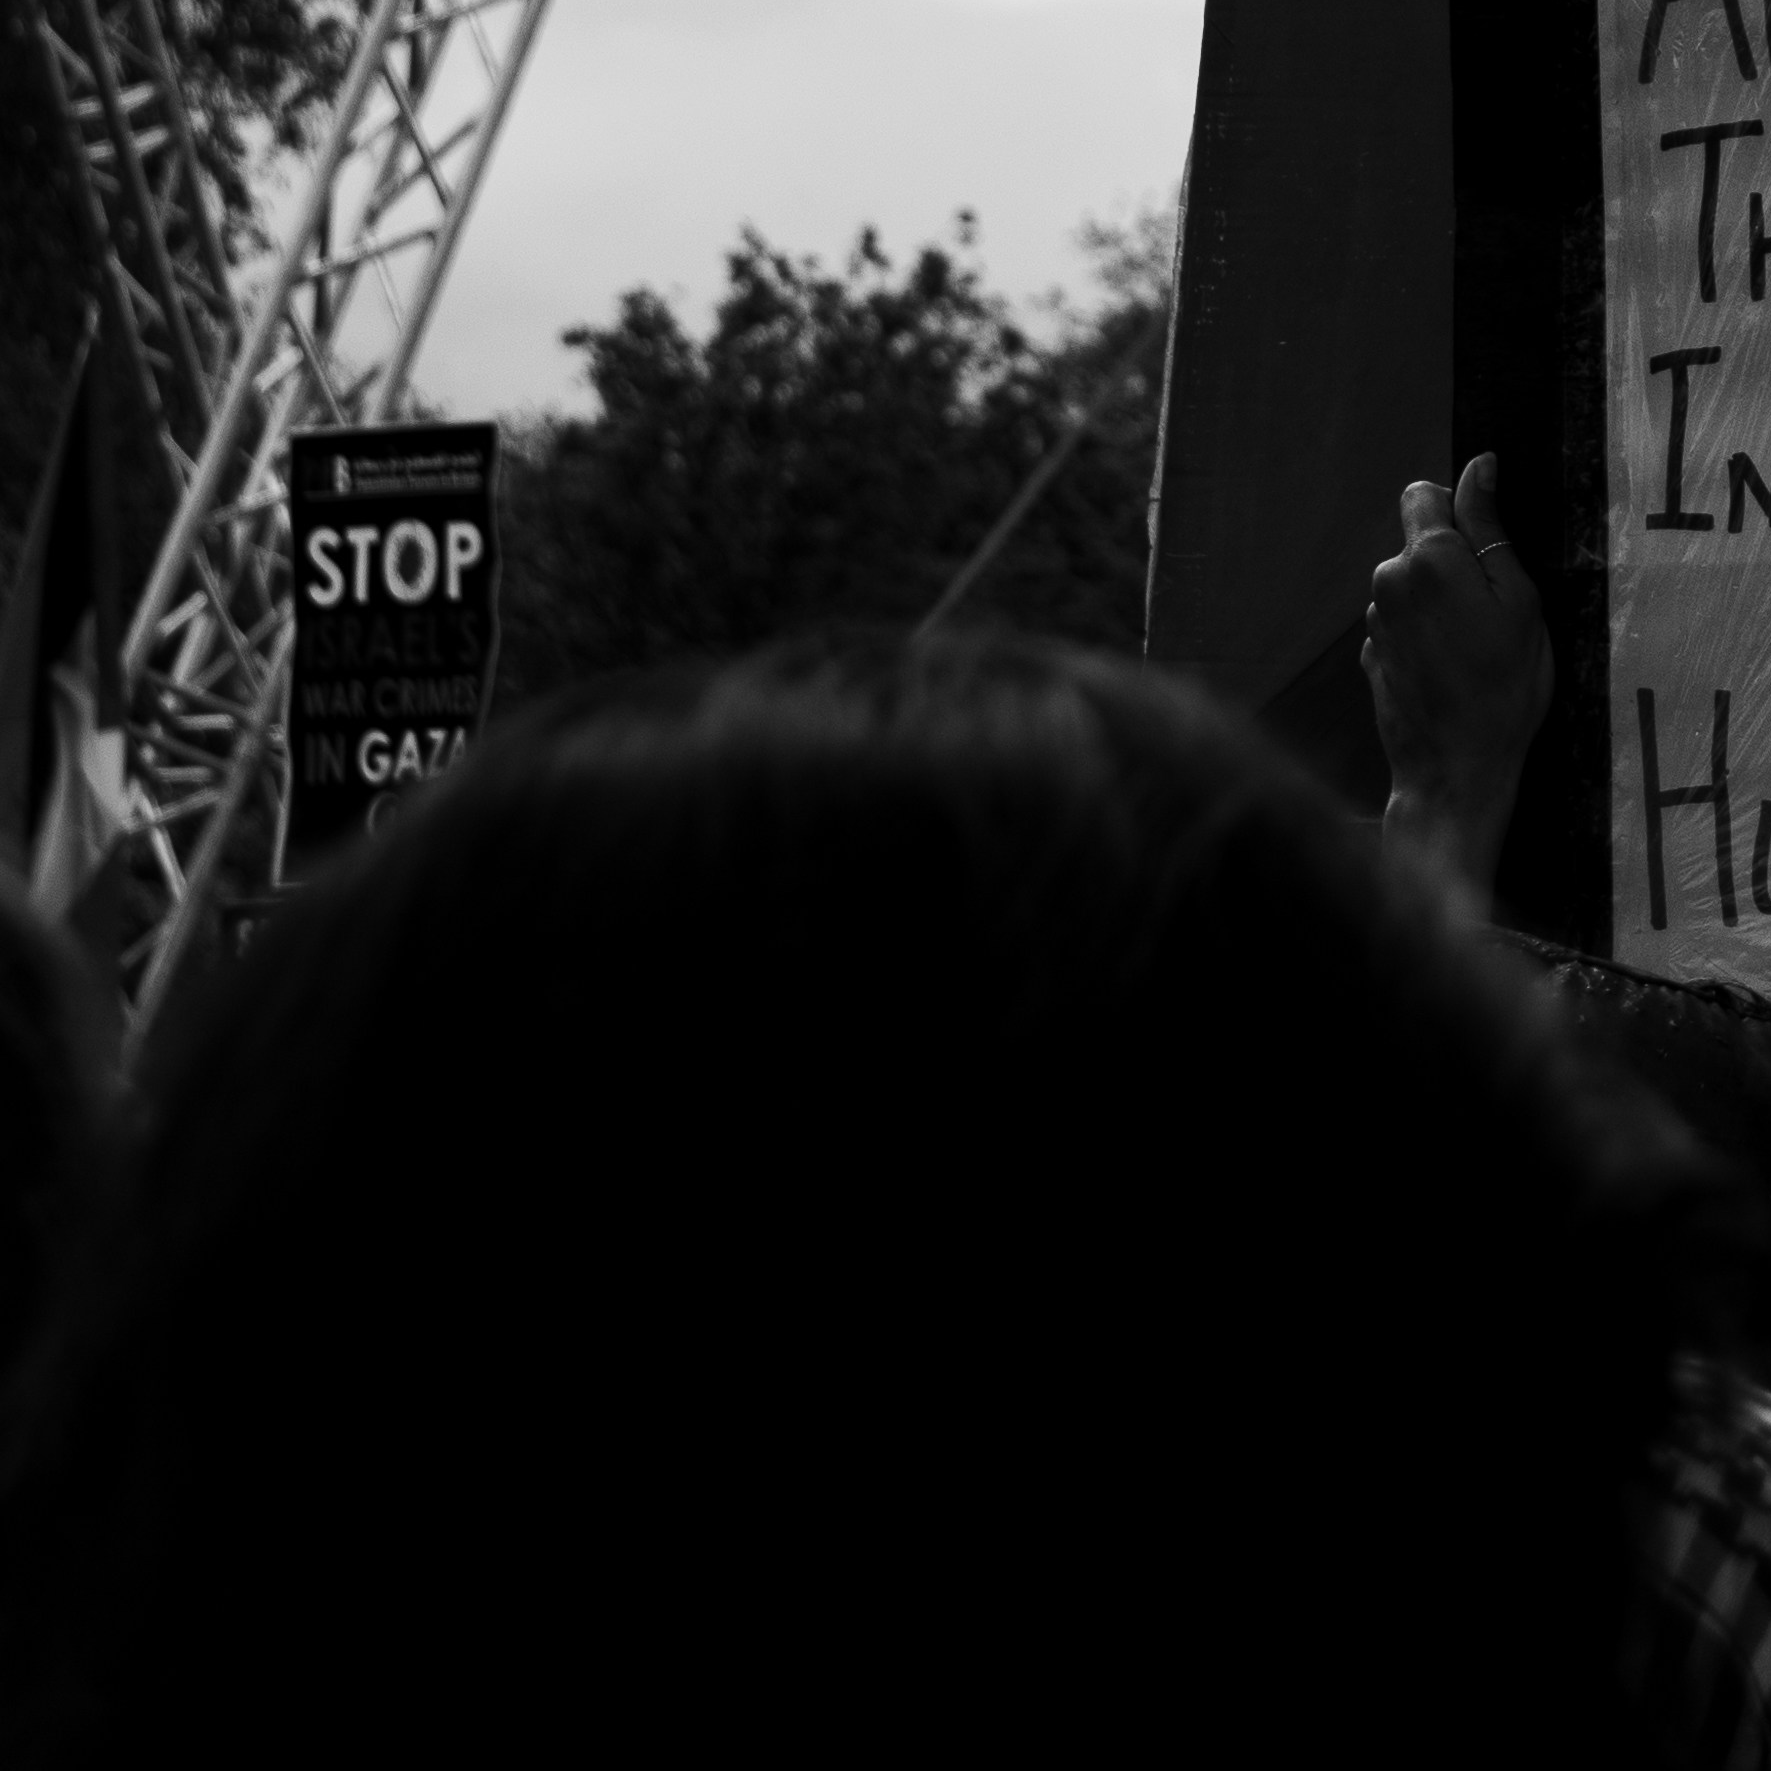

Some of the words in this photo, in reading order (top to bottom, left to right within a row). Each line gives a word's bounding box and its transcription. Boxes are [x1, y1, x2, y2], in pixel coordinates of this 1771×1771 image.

[303, 518, 485, 609] STOP
[301, 609, 482, 671] ISRAEL'S
[301, 679, 367, 719] WAR
[303, 732, 347, 786] IN
